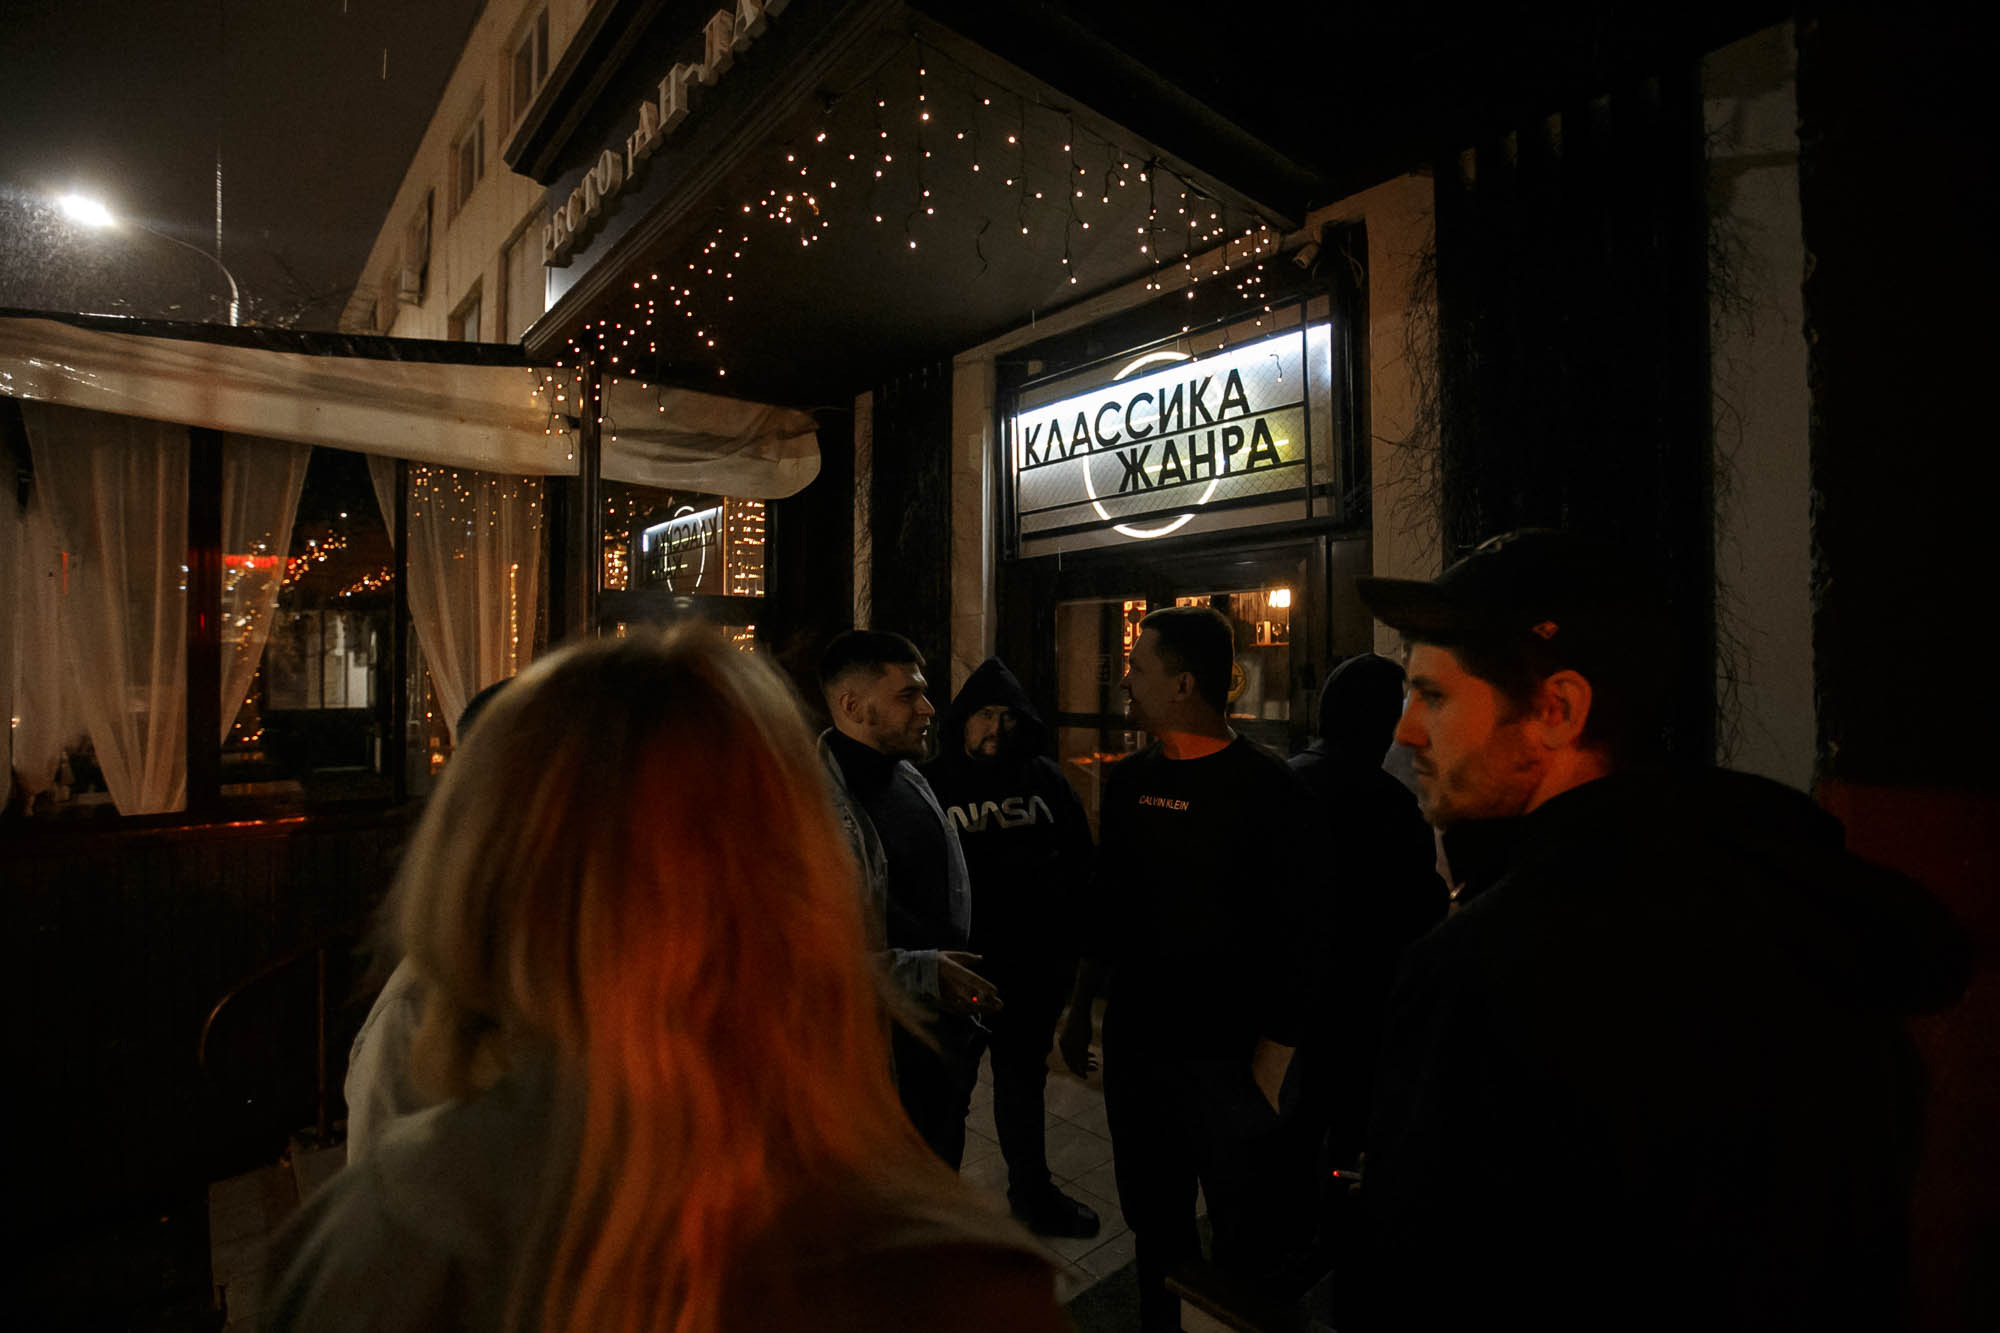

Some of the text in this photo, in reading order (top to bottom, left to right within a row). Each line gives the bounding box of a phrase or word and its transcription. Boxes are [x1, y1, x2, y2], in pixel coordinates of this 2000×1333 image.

[1025, 368, 1251, 466] КЛАССИКА
[1116, 418, 1281, 493] ЖАНРА
[946, 795, 1054, 832] NASA
[1138, 795, 1190, 811] CALVIN KLEIN
